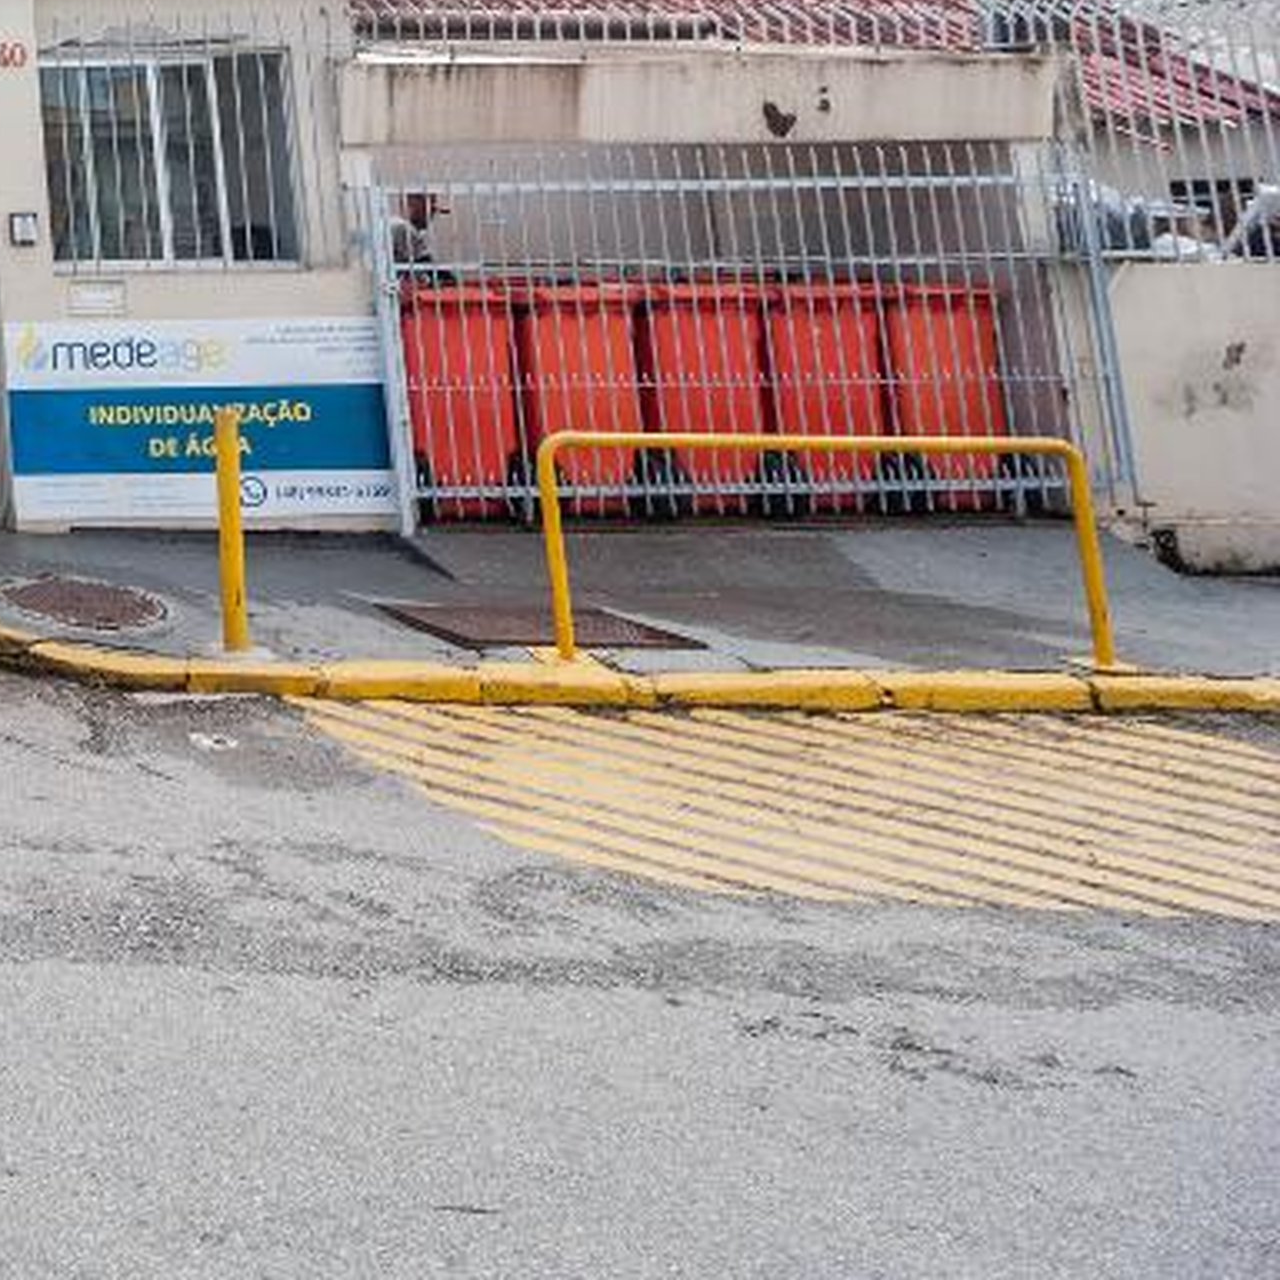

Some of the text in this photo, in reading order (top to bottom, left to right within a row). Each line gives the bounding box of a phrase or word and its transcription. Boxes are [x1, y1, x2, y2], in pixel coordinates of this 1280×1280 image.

[89, 400, 311, 426] INDIVIDUAZAÇÃO
[149, 433, 252, 457] DE ÁGA
